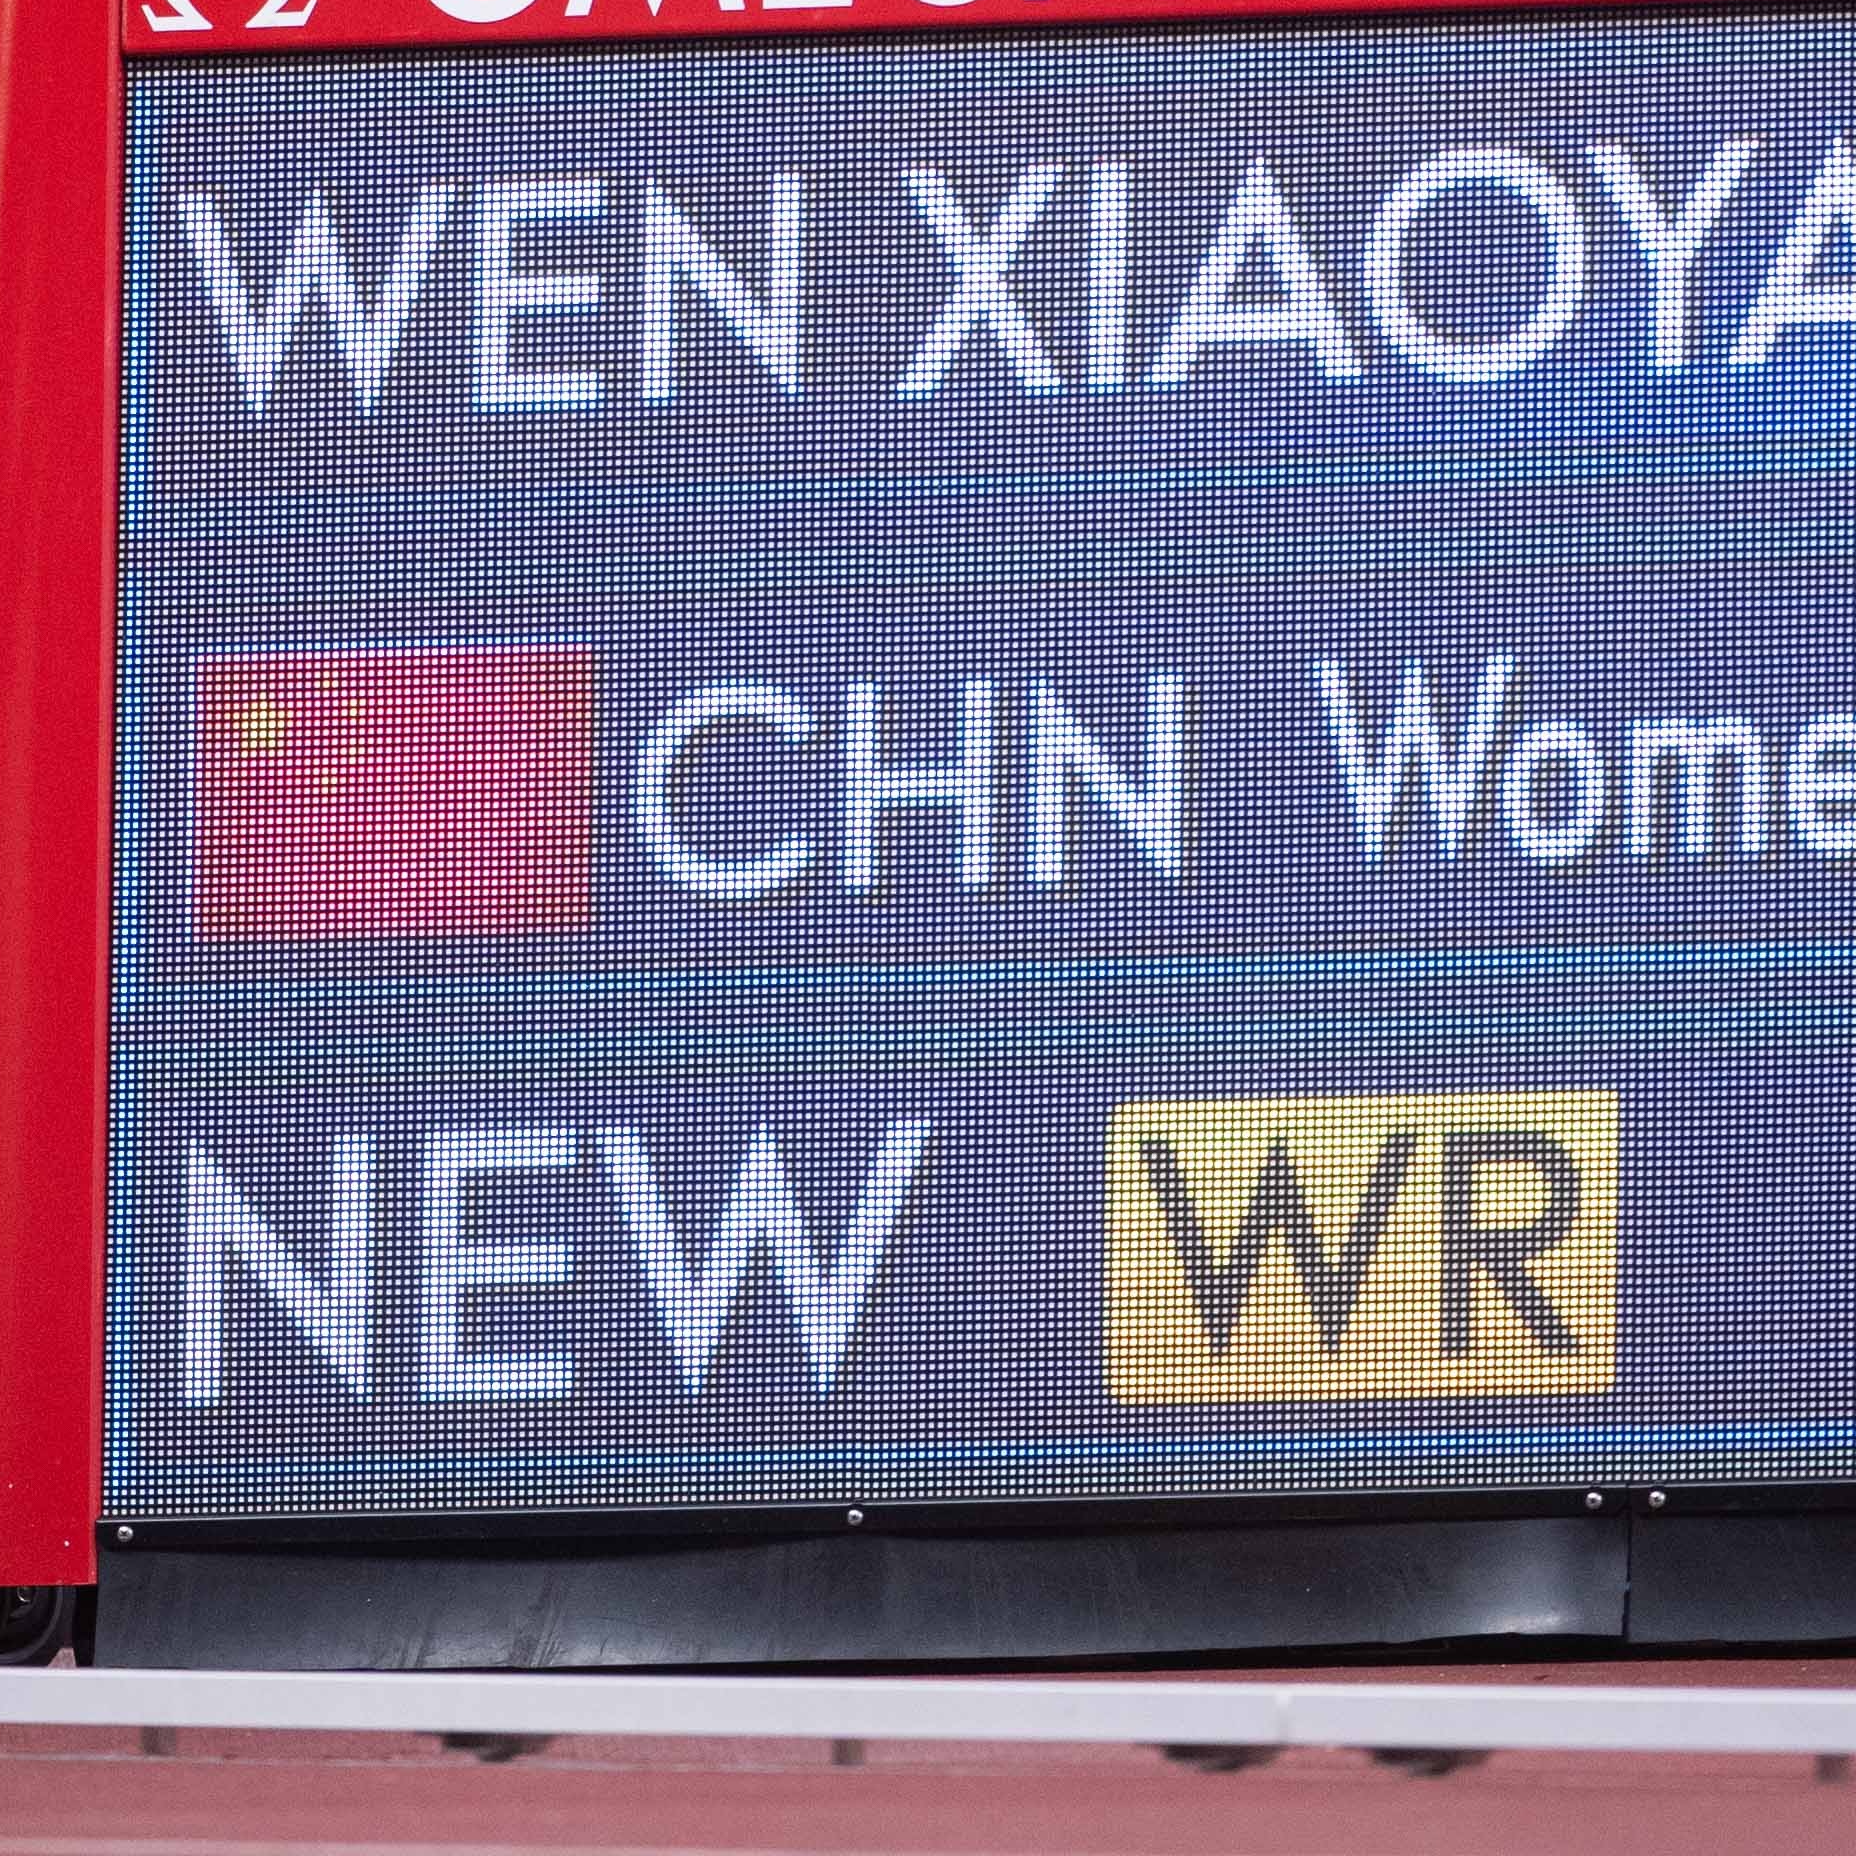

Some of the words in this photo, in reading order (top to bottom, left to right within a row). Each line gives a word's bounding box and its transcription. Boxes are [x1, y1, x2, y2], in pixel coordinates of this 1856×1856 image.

[175, 168, 808, 423] WEN
[633, 670, 1187, 899] CHN
[182, 1118, 935, 1409] NEW
[1140, 1128, 1584, 1362] WR
